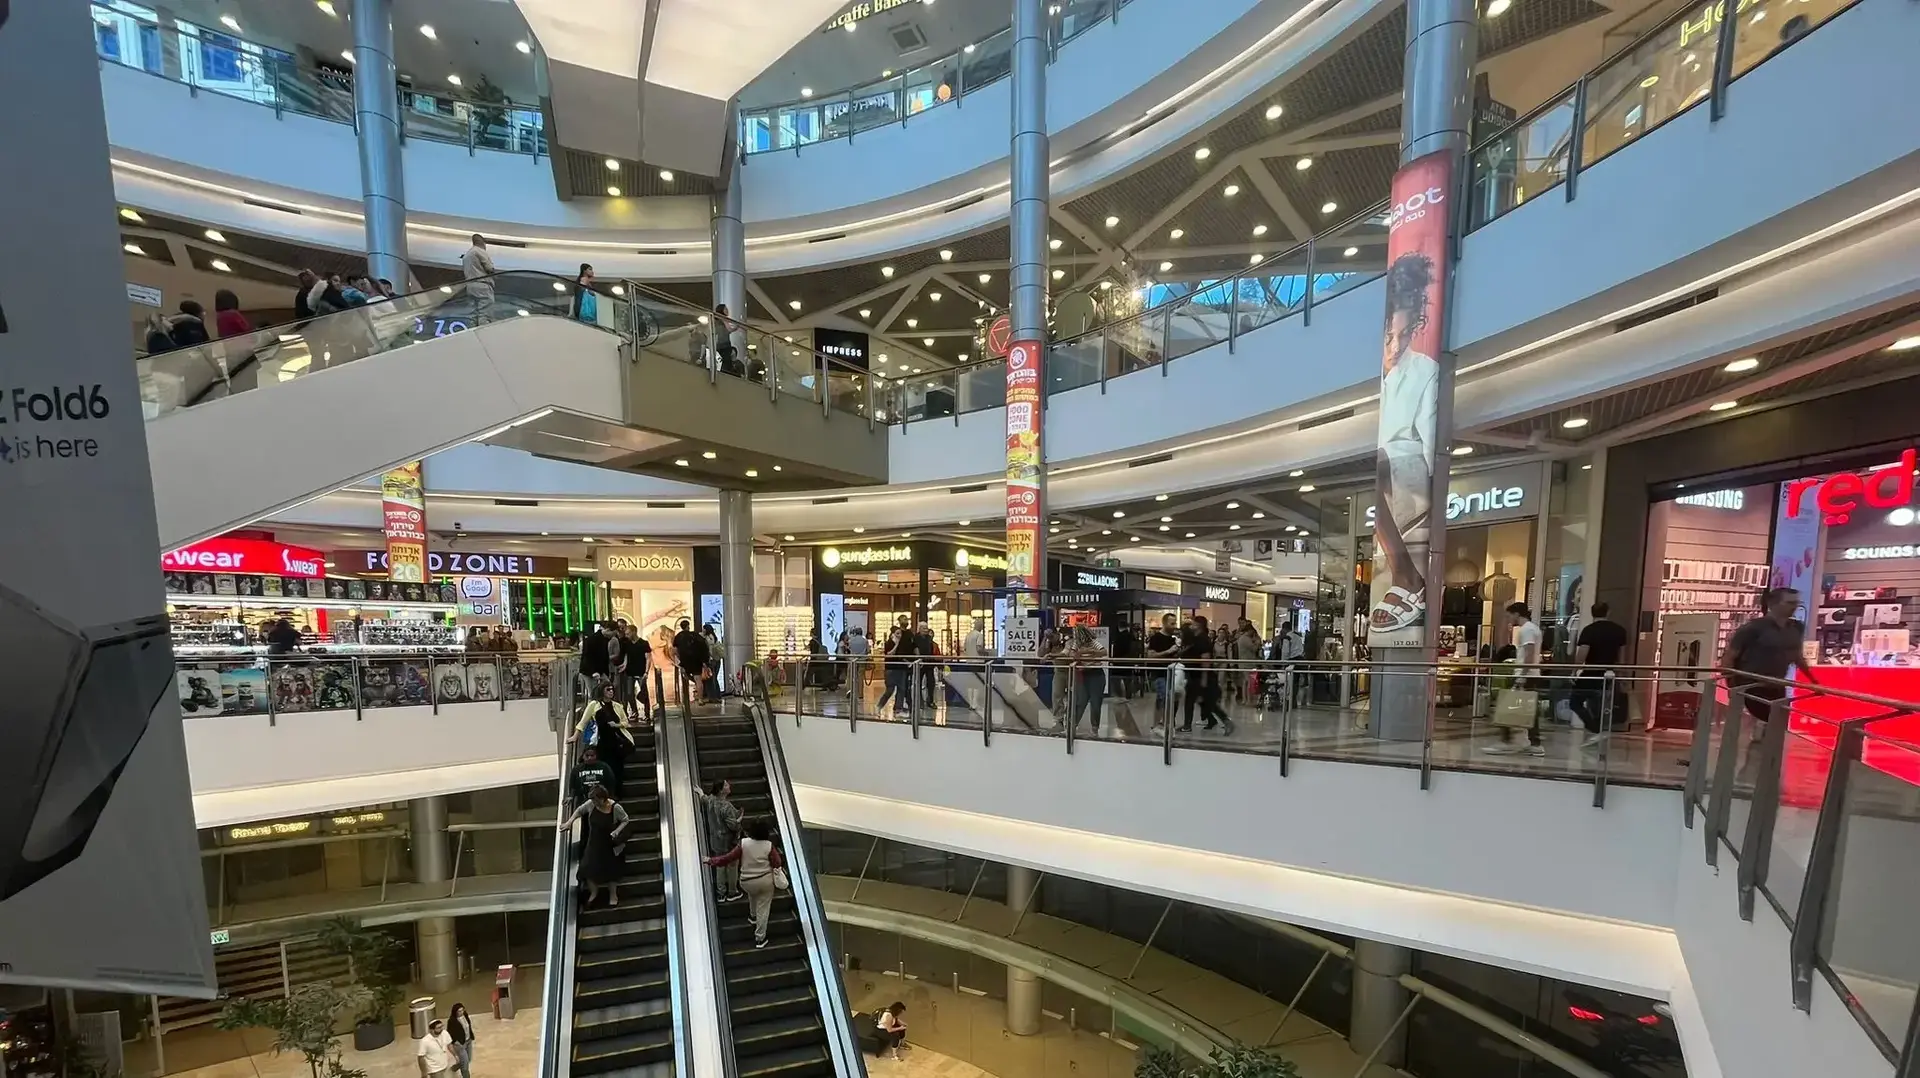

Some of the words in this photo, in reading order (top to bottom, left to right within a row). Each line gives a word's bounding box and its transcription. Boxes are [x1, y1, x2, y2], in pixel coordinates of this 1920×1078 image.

[822, 345, 863, 358] IMPRESS
[11, 384, 110, 422] Fold6
[14, 436, 31, 459] is
[36, 435, 99, 458] here
[1786, 449, 1916, 520] red
[162, 550, 244, 568] .wear
[840, 547, 890, 565] sunglass
[890, 546, 911, 560] hut
[1845, 545, 1914, 560] SOUNDS
[282, 549, 318, 576] S.wear
[449, 555, 518, 574] ZONE
[525, 558, 534, 574] 1
[608, 556, 683, 570] PANDORA
[1205, 586, 1230, 600] MANGO
[1008, 630, 1036, 640] SALE!
[1028, 640, 1036, 652] 2
